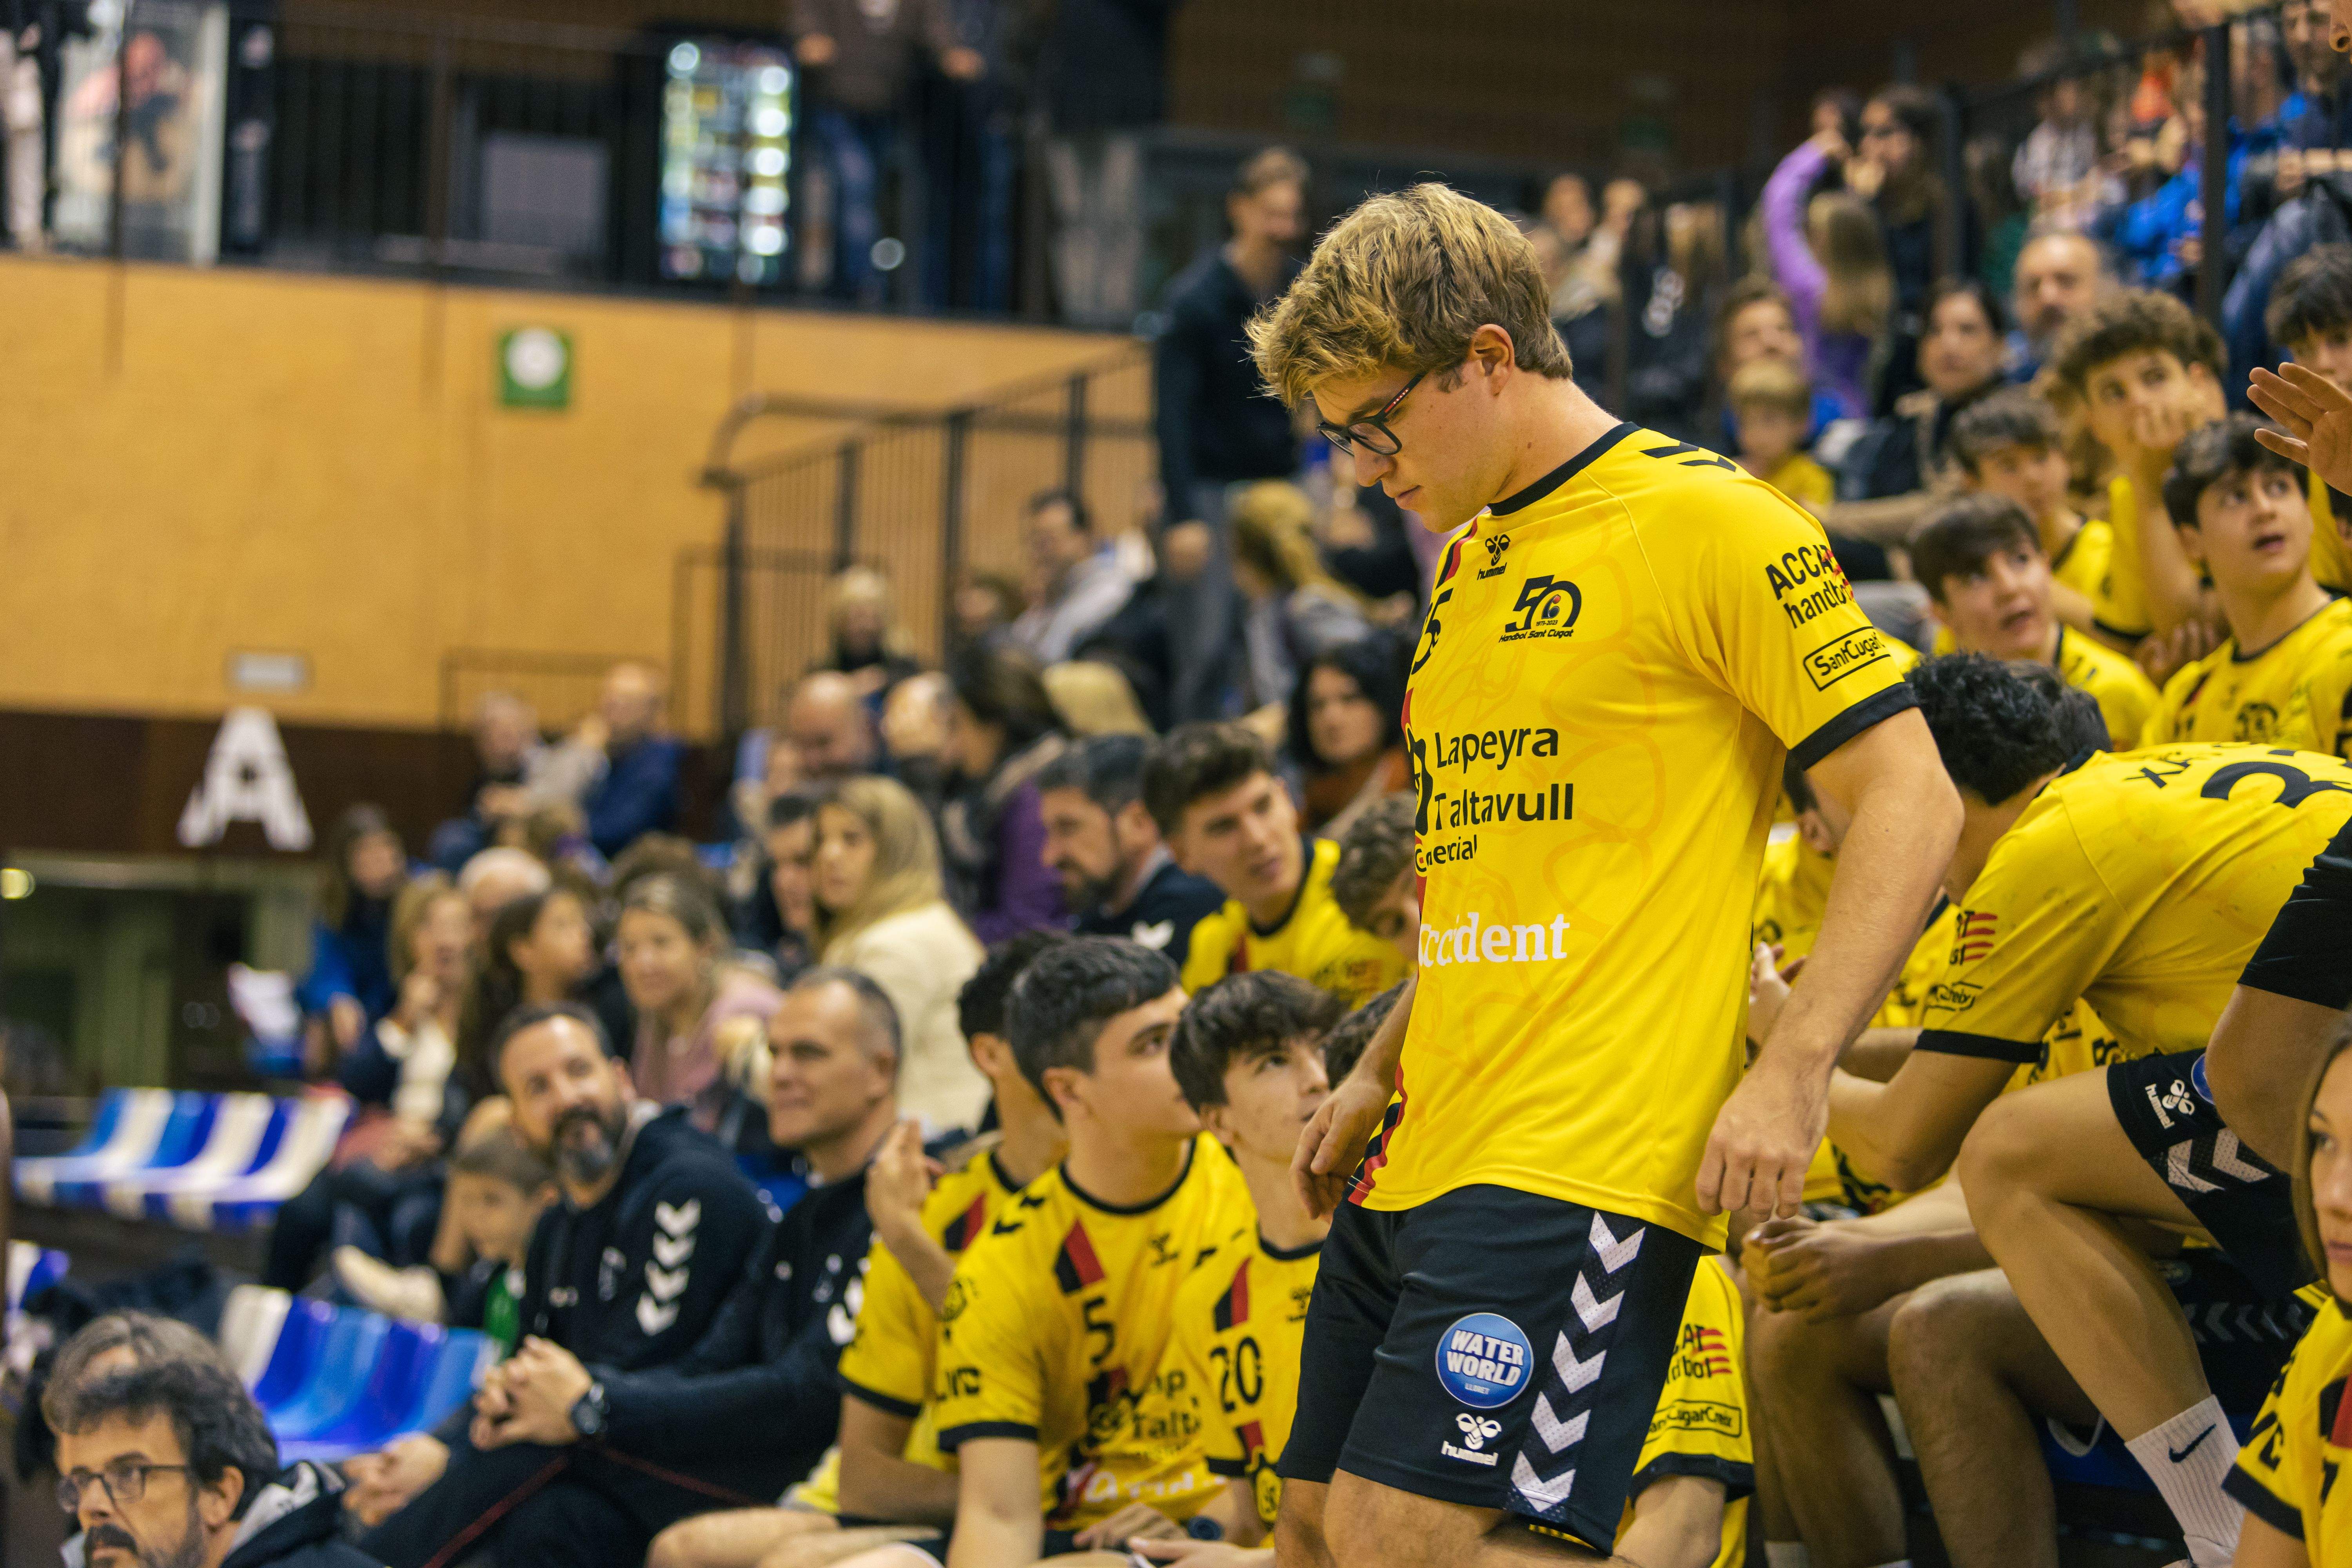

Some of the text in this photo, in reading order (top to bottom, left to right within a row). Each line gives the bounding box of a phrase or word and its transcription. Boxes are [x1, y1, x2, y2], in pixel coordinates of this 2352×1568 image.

[1477, 563, 1507, 580] hummel
[1783, 579, 1853, 629] handb
[1411, 588, 1454, 675] 5
[1498, 629, 1574, 643] Handbol Sant Cugat
[1434, 728, 1559, 774] Lapeyra
[176, 705, 314, 852] A
[1434, 783, 1574, 831] Taltavull
[1081, 1294, 1116, 1366] 5
[1450, 1329, 1525, 1366] WATER
[1209, 1336, 1264, 1413] 20
[1446, 1350, 1522, 1387] WORLD
[1441, 1440, 1499, 1466] hummel
